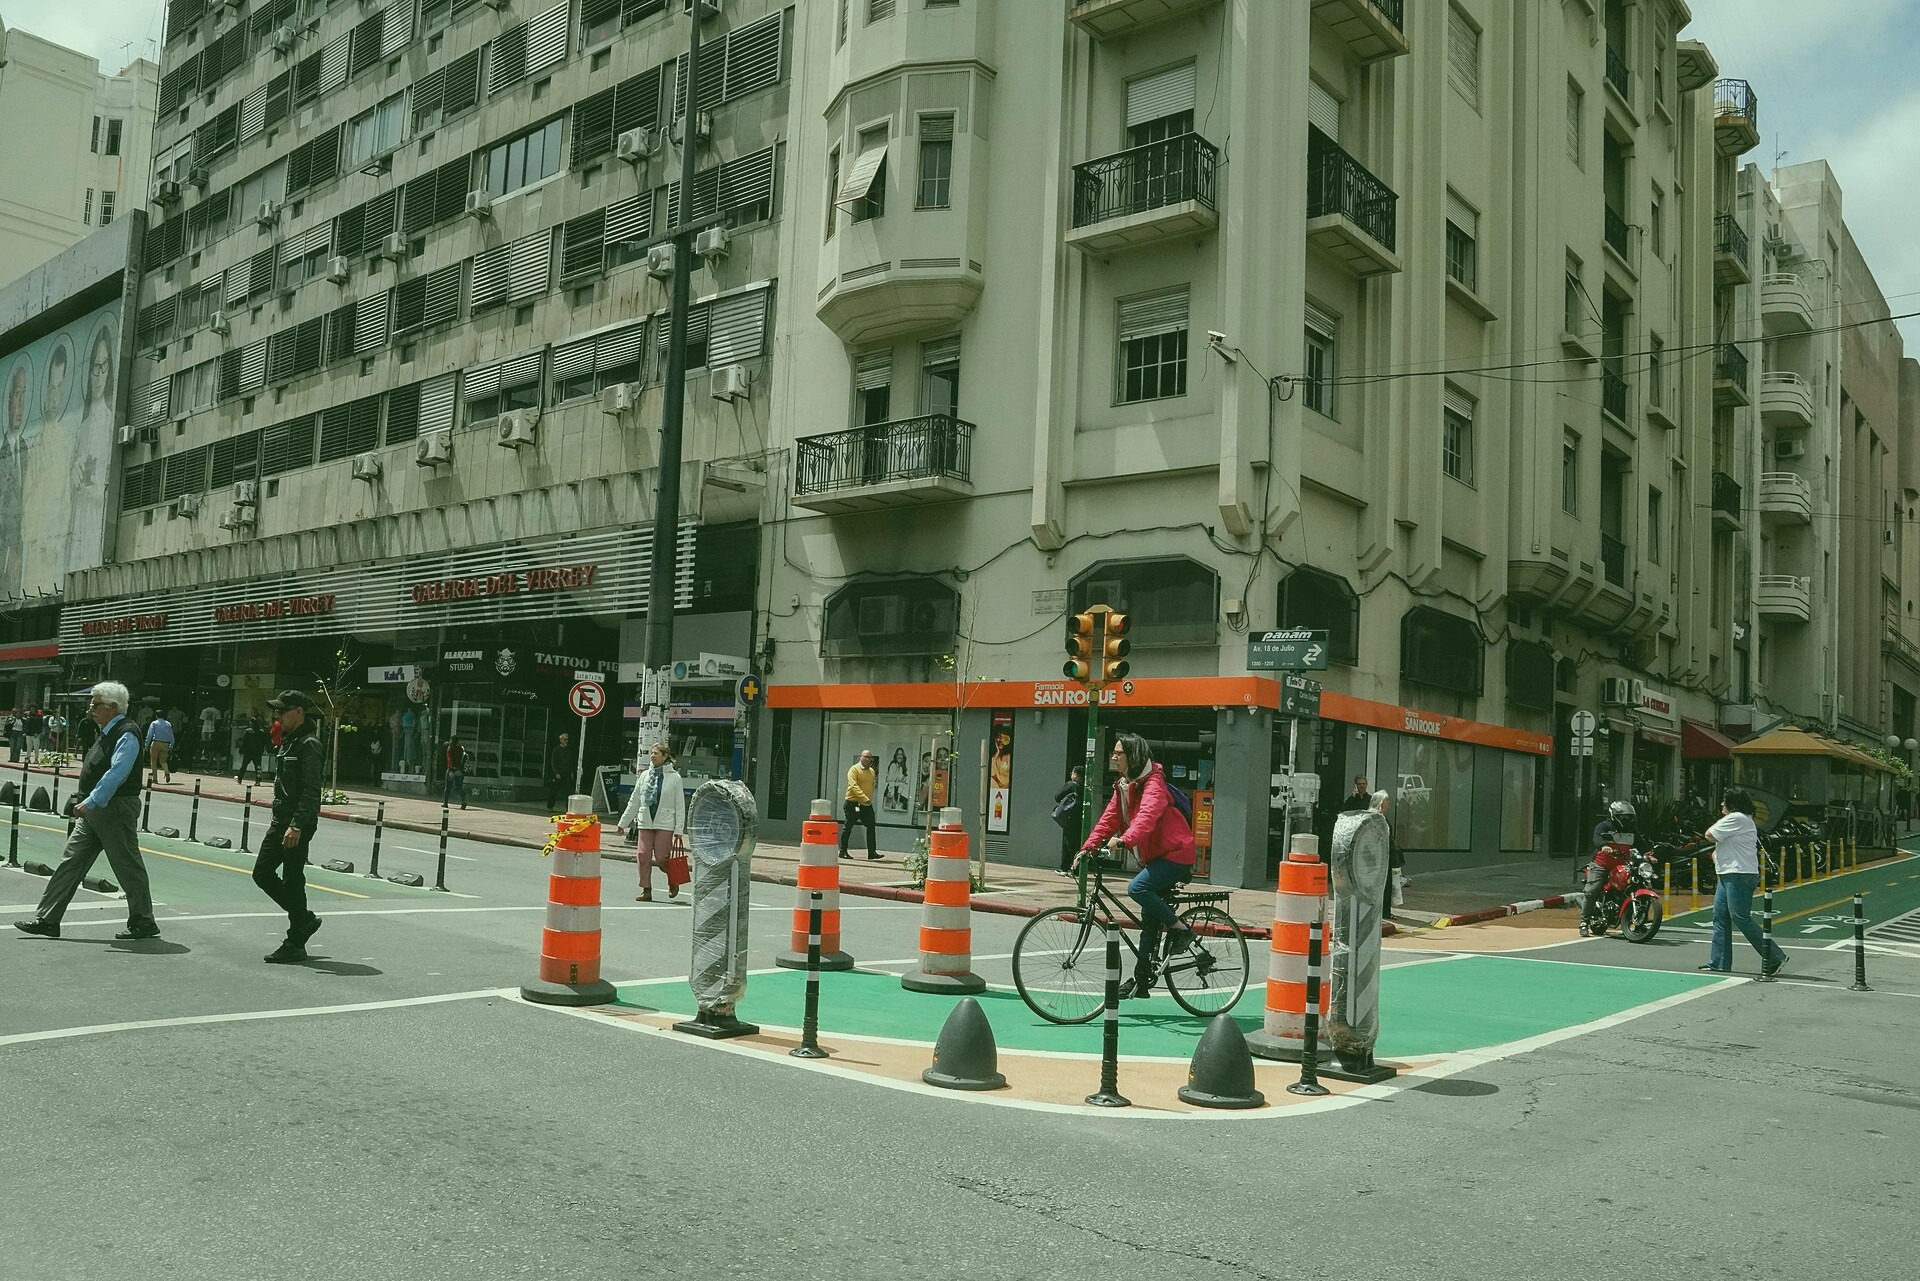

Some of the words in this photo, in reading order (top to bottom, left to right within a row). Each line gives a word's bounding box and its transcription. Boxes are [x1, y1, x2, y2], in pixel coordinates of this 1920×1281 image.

[411, 577, 481, 603] GALERIA
[485, 572, 520, 595] DEL
[524, 564, 598, 592] VIRREY
[214, 603, 259, 623] GALERIA
[262, 600, 284, 618] DEL
[289, 594, 336, 615] VIRREY
[81, 620, 113, 636] GALERIA
[116, 617, 132, 633] DEL
[135, 613, 168, 630] VIRREY
[1261, 631, 1312, 642] panam
[1280, 644, 1295, 652] Julio
[449, 663, 474, 671] STUDIO
[535, 652, 590, 669] TATTOO
[1034, 682, 1064, 690] Farmacia
[1034, 690, 1063, 705] SAN
[1065, 690, 1117, 705] ROUE
[1405, 717, 1418, 731] SAN
[1419, 719, 1441, 735] ROQUE
